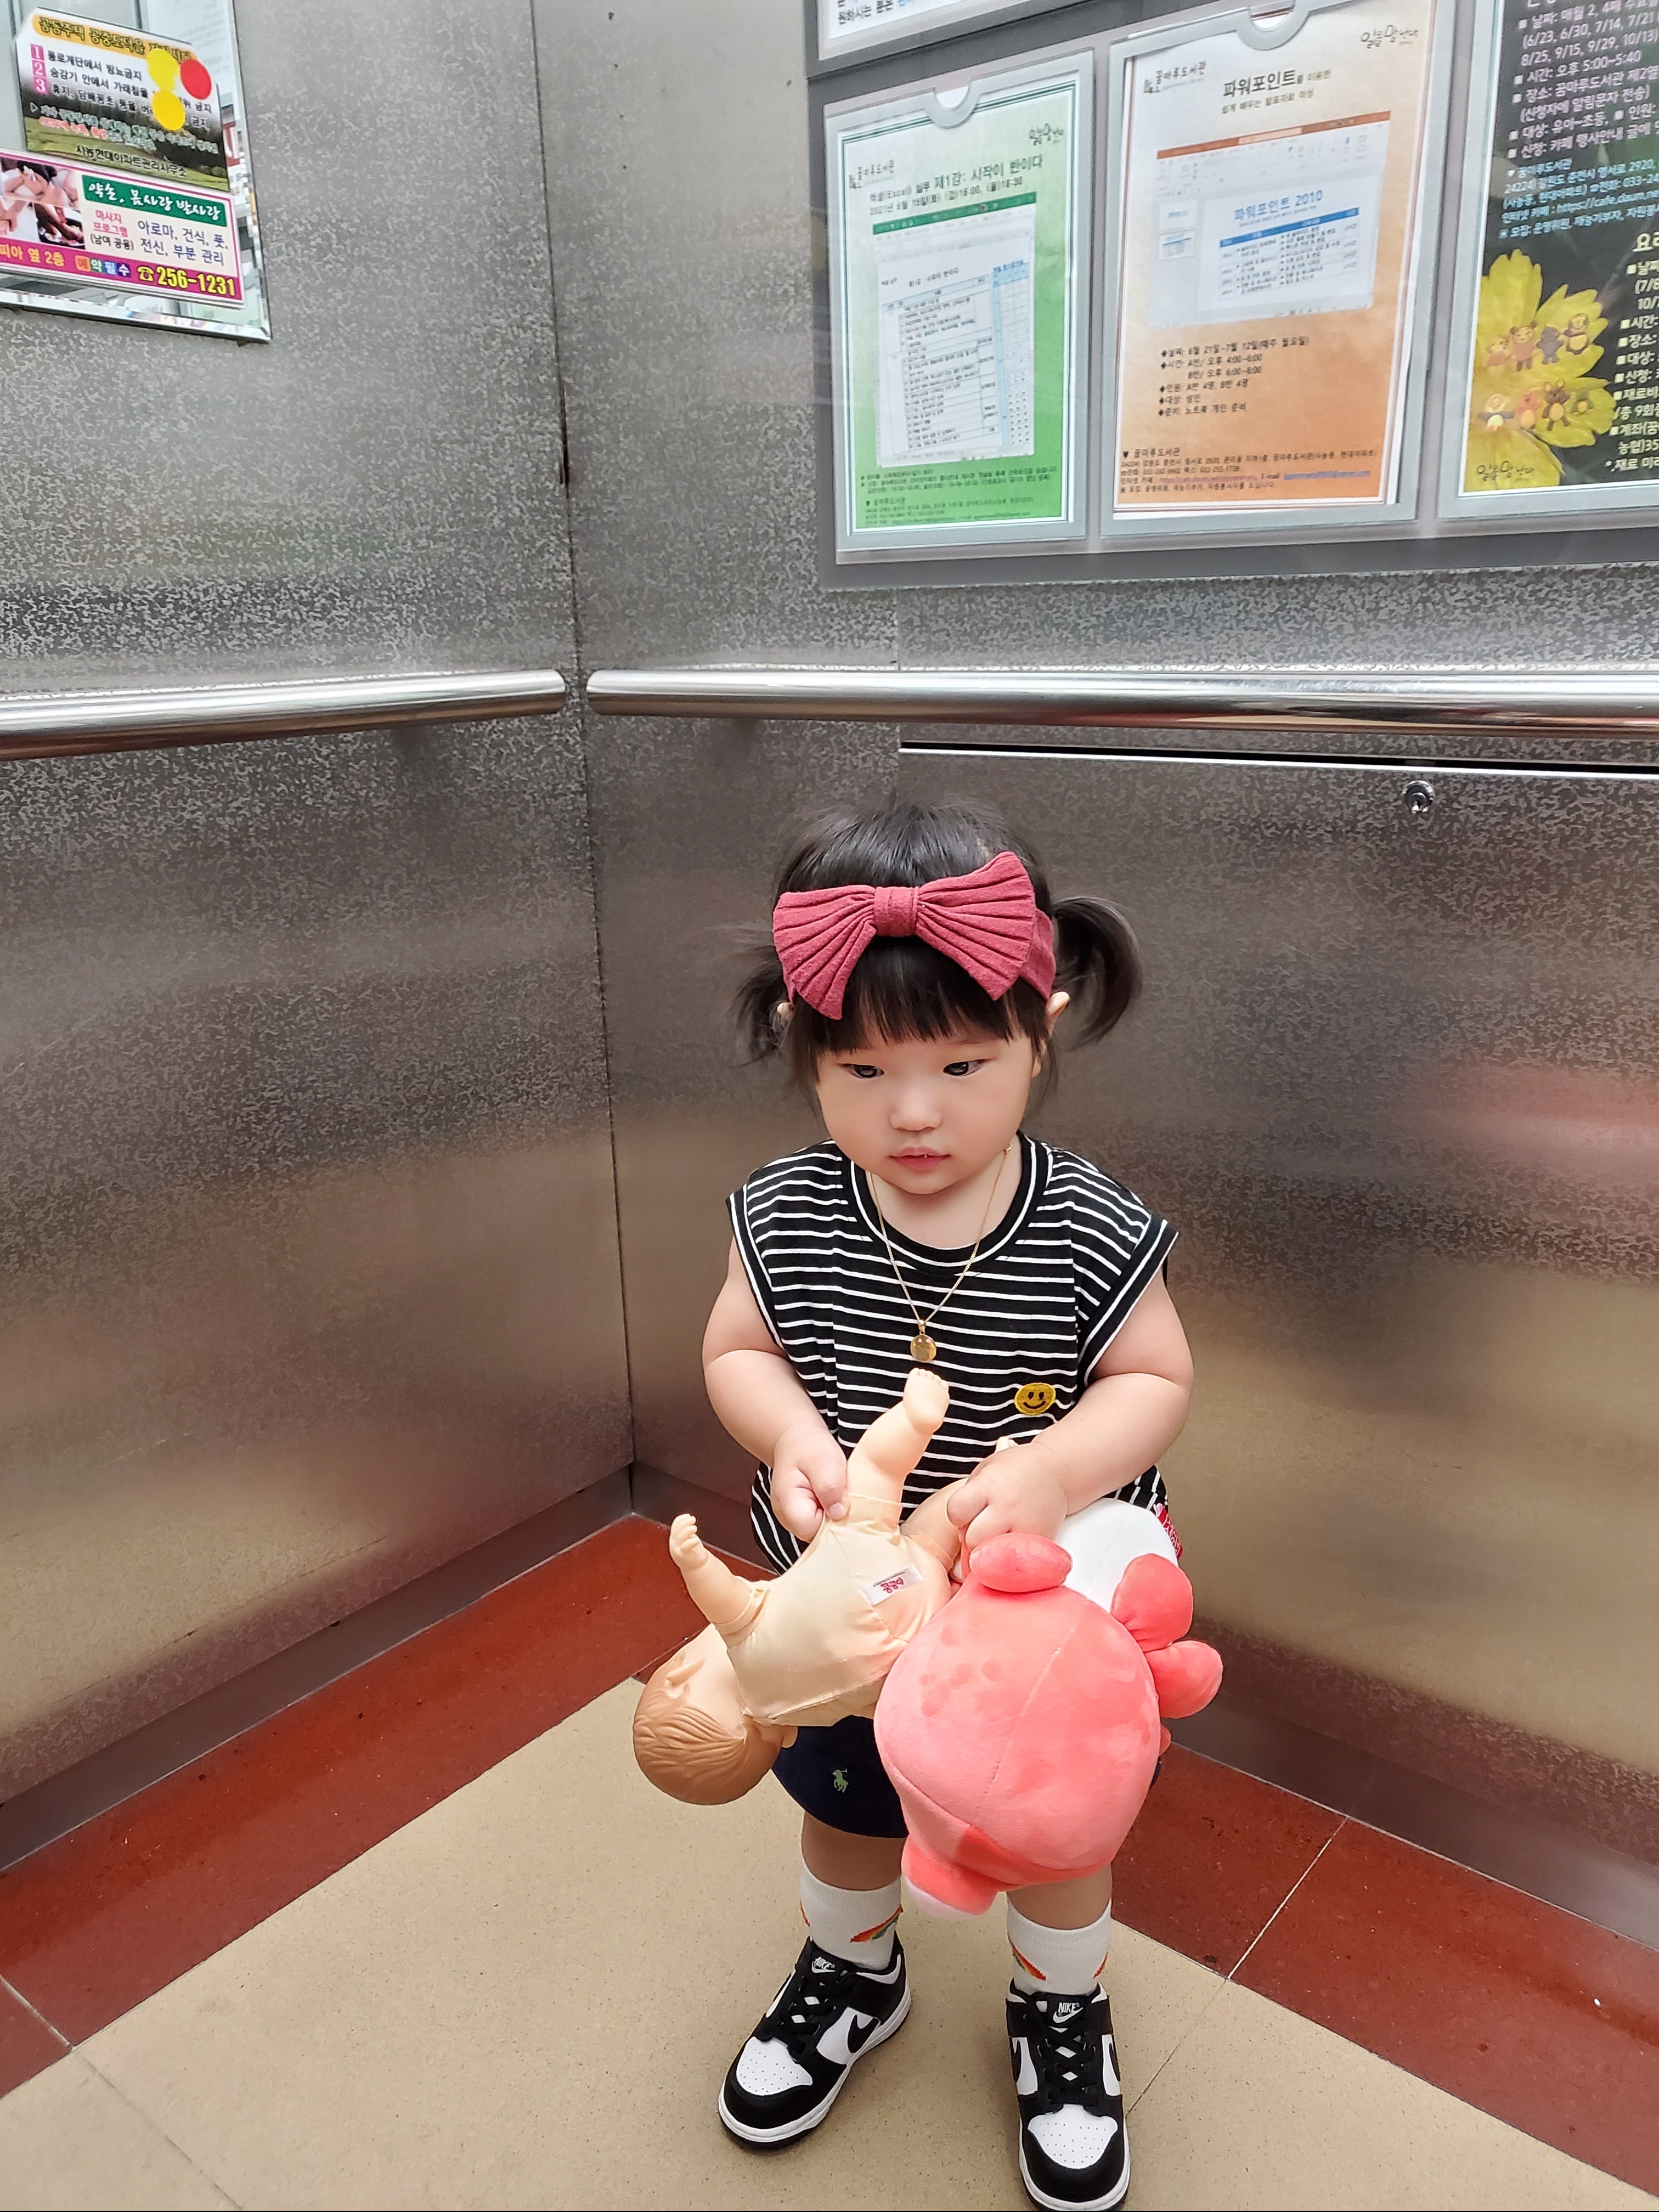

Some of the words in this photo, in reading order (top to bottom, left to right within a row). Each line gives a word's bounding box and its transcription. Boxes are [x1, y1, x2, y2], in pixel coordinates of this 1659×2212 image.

[38, 15, 85, 41] 공동주택
[88, 27, 145, 55] 공중도덕을
[1522, 29, 1558, 49] (6/23,
[1560, 22, 1592, 42] 6/30,
[1594, 16, 1624, 36] 7/14,
[33, 46, 41, 58] 1
[48, 50, 101, 72] 통로계단에서
[106, 64, 142, 81] 방뇨금지
[1520, 48, 1551, 67] 8/25,
[1554, 42, 1585, 61] 9/15,
[1587, 35, 1620, 55] 9/29,
[34, 61, 43, 75] 2
[49, 66, 77, 82] 승강기
[82, 74, 109, 89] 안에서
[113, 81, 148, 98] 가래침을
[1526, 67, 1553, 84] 시간:
[1555, 60, 1579, 78] 오후
[36, 78, 46, 92] 3
[77, 89, 114, 106] 담배꽁초
[1525, 86, 1552, 104] 장소:
[1554, 71, 1624, 98] 꿈마루도서관
[1571, 90, 1618, 112] 알림문자
[1521, 121, 1549, 140] 대상:
[1628, 102, 1656, 121] 인원:
[1549, 135, 1573, 153] 카페
[972, 161, 1003, 183] 시작이
[1009, 153, 1042, 174] 반이다
[88, 180, 124, 203] 약손,
[129, 188, 172, 212] 몸사랑
[176, 198, 221, 222] 발사랑
[1234, 193, 1291, 222] 파워포인트
[1295, 189, 1323, 208] 2010
[93, 221, 128, 237] 프로그램
[95, 210, 122, 224] 마사지
[90, 233, 111, 247] (남여
[113, 237, 134, 251] 공용)
[138, 219, 177, 241] 아로마,
[182, 228, 209, 246] 건식,
[140, 238, 168, 256] 전신,
[173, 244, 197, 261] 부분
[201, 249, 224, 266] 관리
[28, 248, 41, 263] 옆
[44, 251, 65, 267] 2층
[157, 266, 236, 296] 256-1231
[1630, 313, 1659, 330] 시간:
[1628, 332, 1657, 349] 장소:
[1626, 350, 1655, 367] 대상:
[814, 1956, 832, 1970] NIKE
[1058, 2002, 1076, 2013] NIKE
